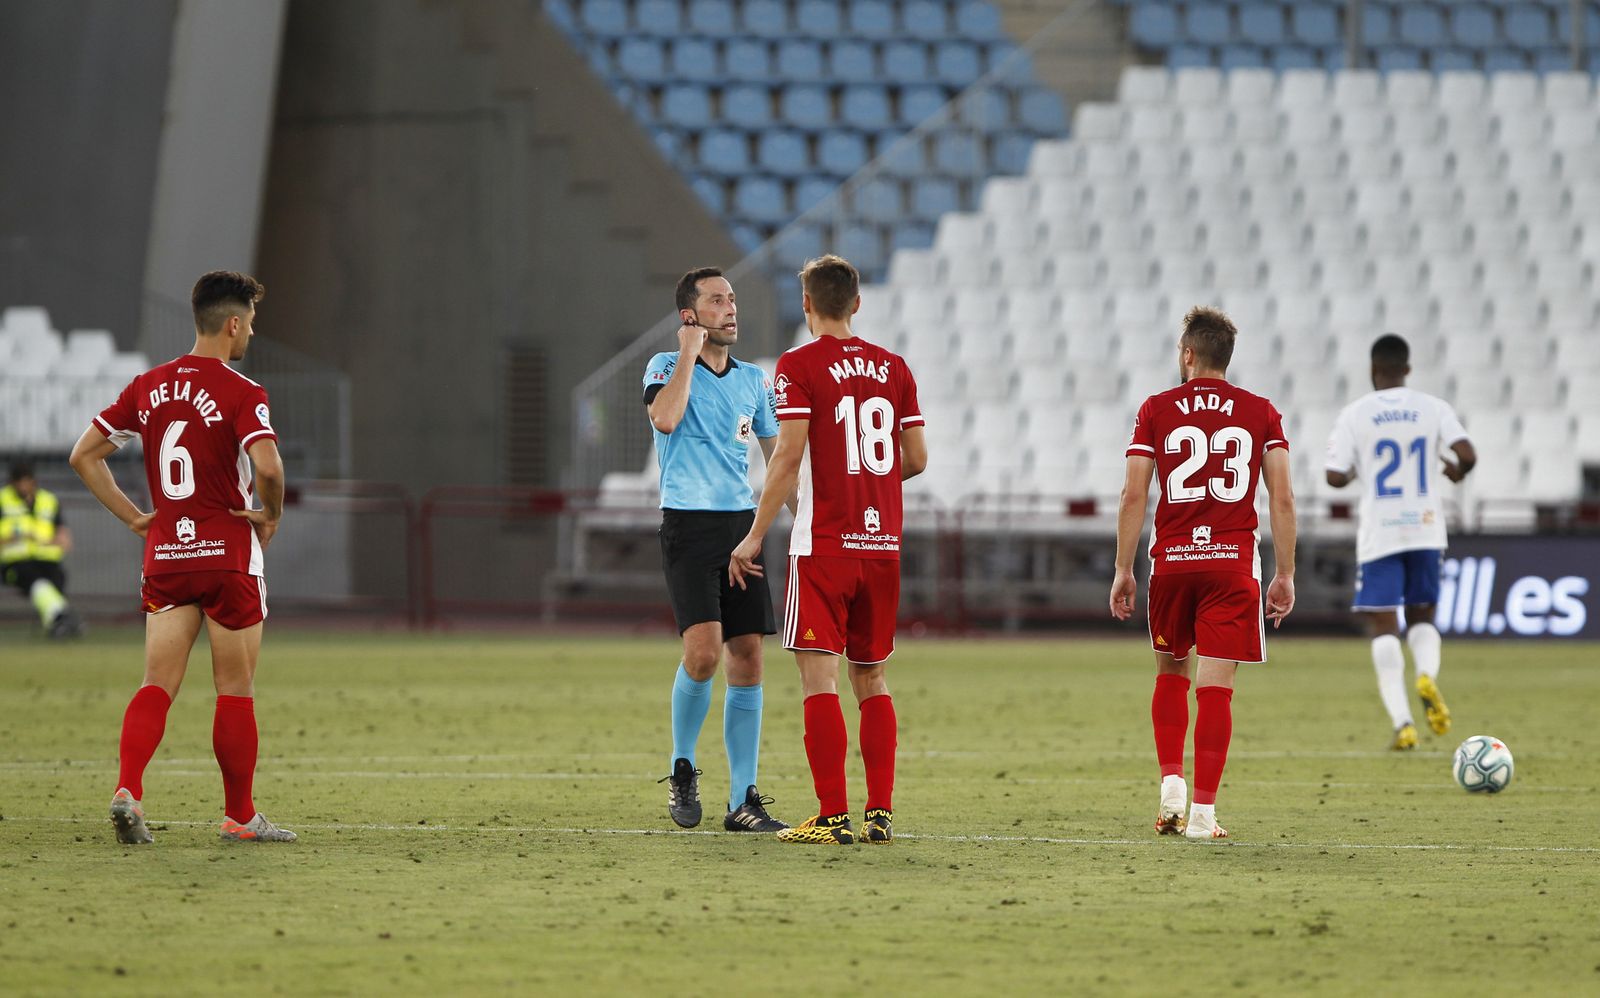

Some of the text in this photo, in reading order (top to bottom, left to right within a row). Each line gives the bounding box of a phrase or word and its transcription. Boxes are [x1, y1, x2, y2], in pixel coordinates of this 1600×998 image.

[149, 382, 170, 409] DE
[174, 380, 192, 401] LA
[192, 388, 224, 428] HOZ
[835, 395, 895, 476] 18
[1174, 393, 1235, 417] VADA
[159, 419, 196, 501] 6
[1164, 425, 1254, 504] 23
[1374, 435, 1429, 500] 21
[1436, 556, 1590, 635] ill.es
